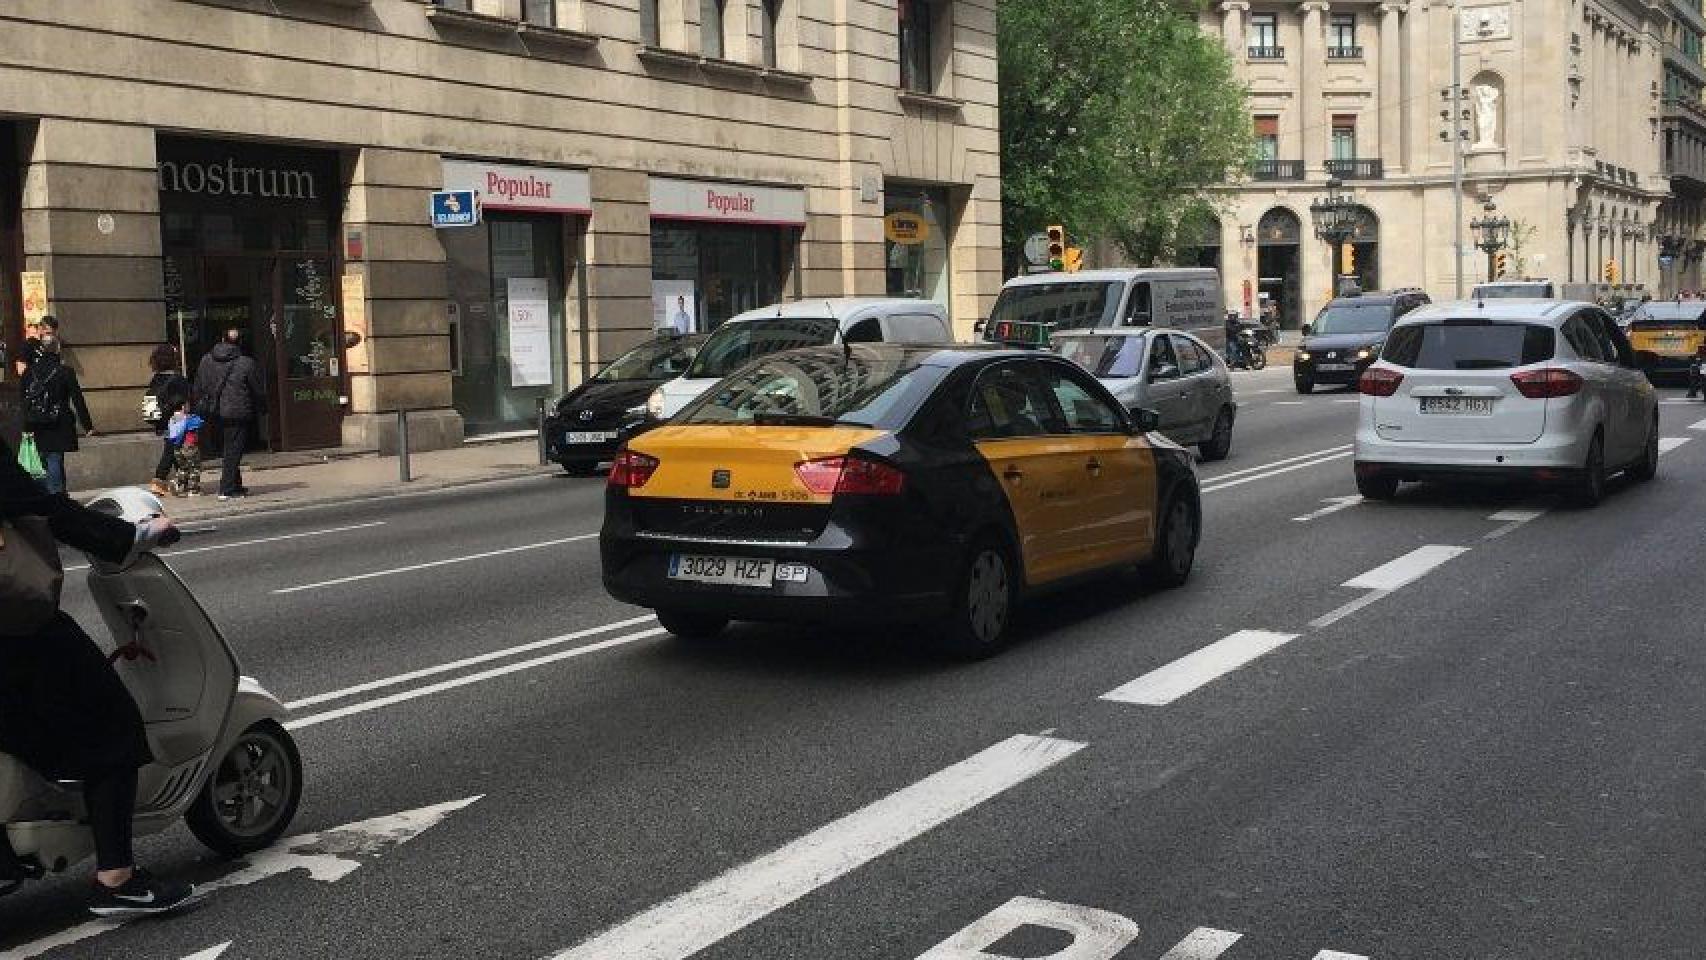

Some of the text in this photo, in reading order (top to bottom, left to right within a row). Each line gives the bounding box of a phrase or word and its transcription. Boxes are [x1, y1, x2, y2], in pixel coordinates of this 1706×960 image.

[158, 157, 317, 199] nostrum
[486, 171, 552, 201] Popular
[707, 189, 755, 215] Popular
[683, 557, 804, 579] 3029 HZF SP
